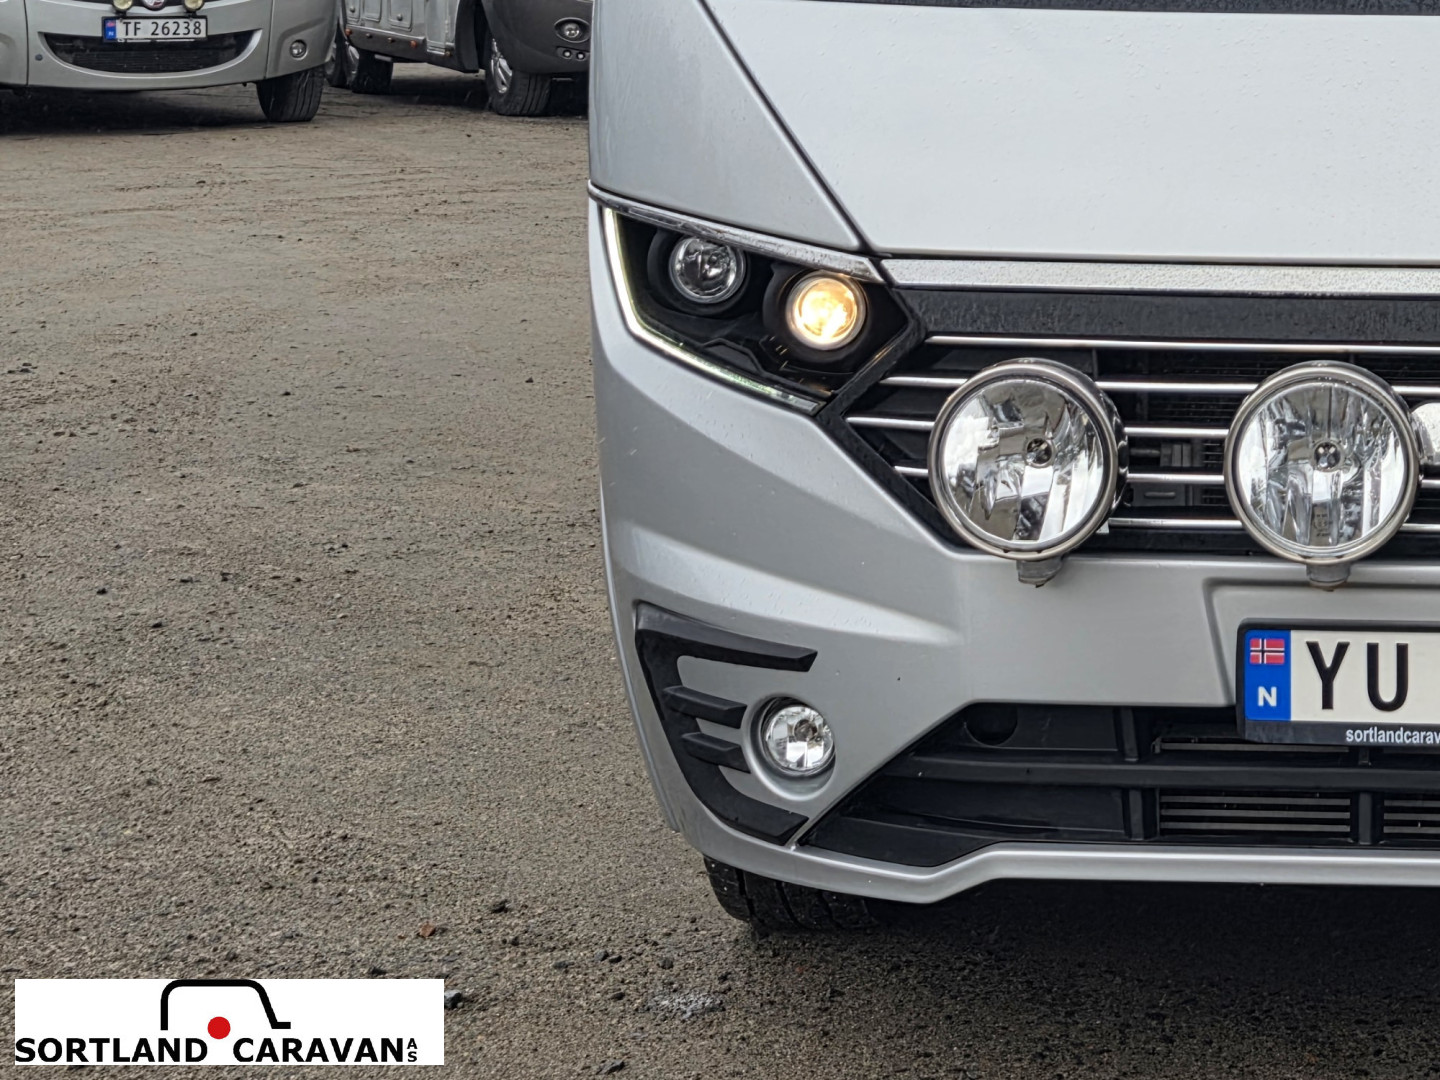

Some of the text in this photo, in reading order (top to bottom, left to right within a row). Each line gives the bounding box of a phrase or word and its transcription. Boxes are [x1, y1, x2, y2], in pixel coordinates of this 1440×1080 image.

[123, 21, 202, 37] TF 26238
[1306, 640, 1409, 712] YU
[1257, 686, 1277, 706] N
